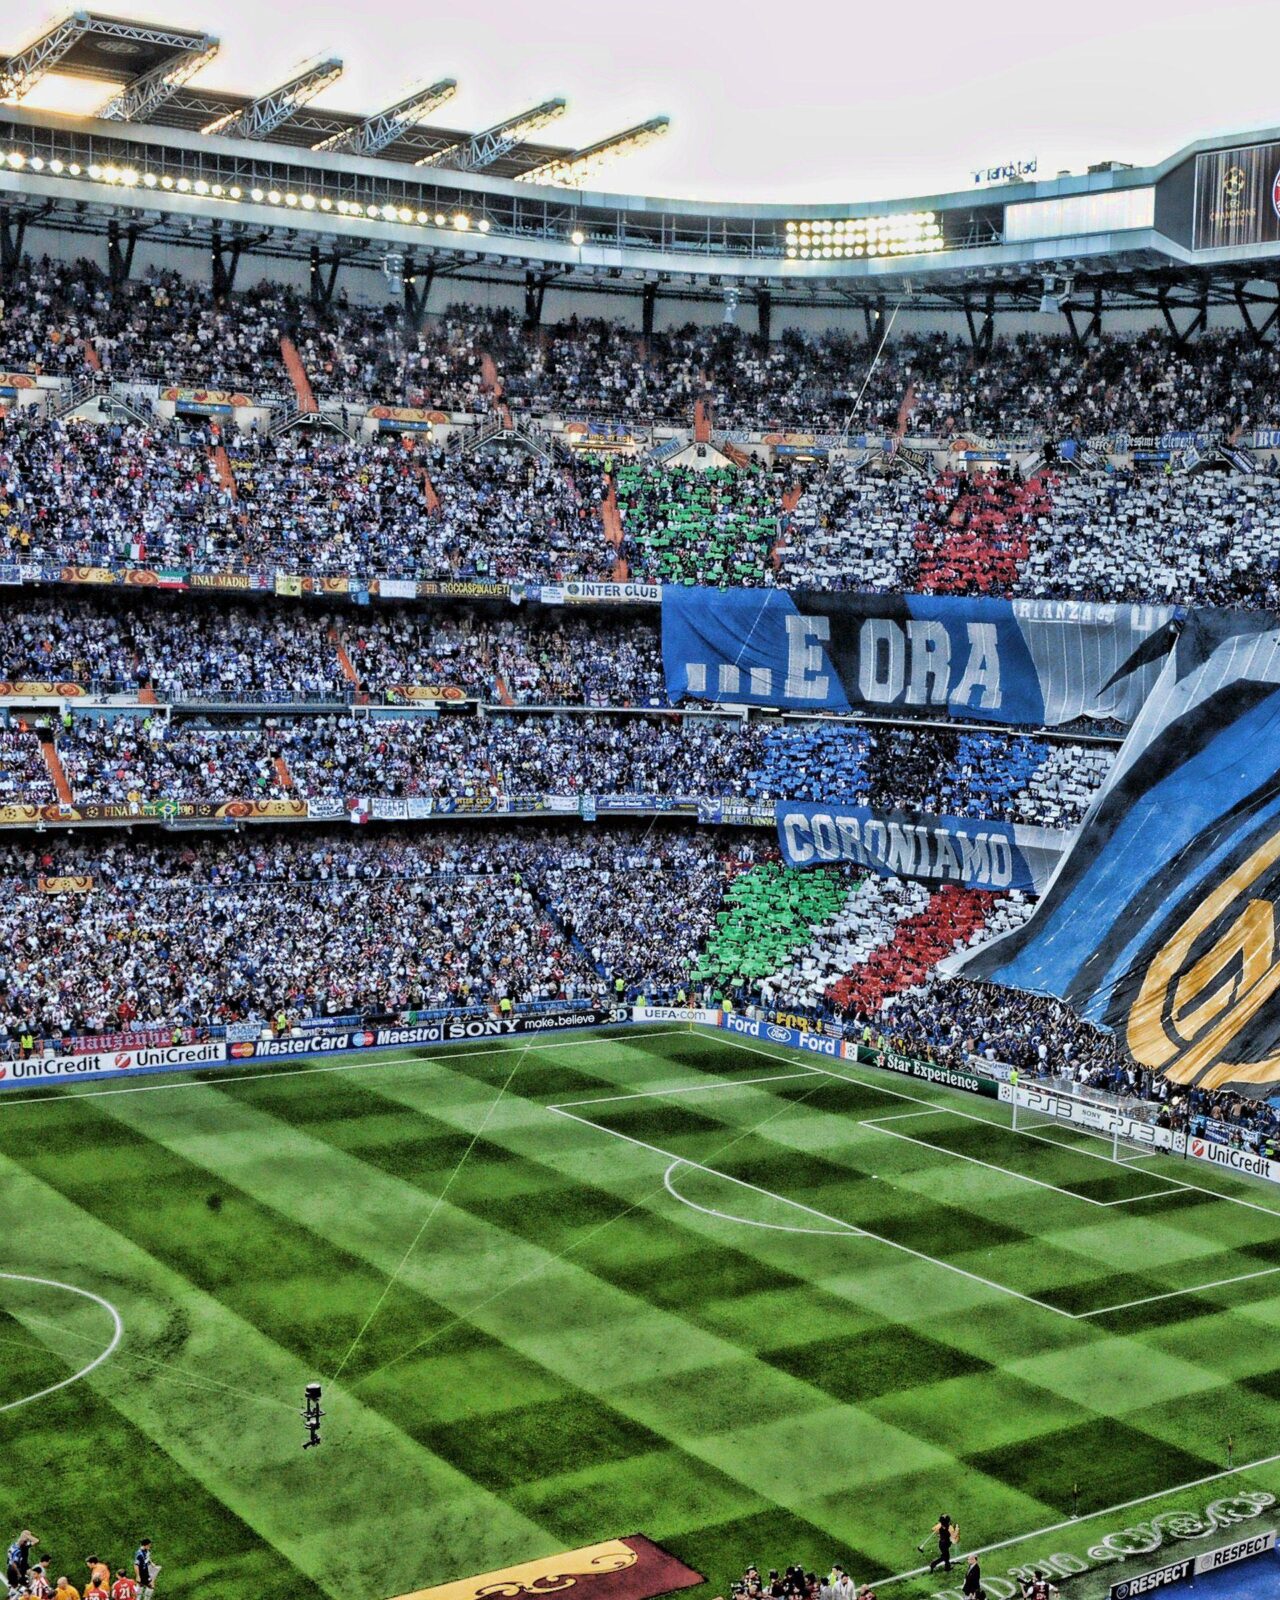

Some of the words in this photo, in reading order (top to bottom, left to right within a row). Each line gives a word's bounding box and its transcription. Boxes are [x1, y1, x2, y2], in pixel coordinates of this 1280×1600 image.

[582, 584, 620, 597] INTER
[624, 585, 658, 599] CLUB
[859, 618, 1002, 708] ORA
[783, 812, 1013, 887] CORONIAMO
[376, 1027, 440, 1046] Maestro
[449, 1019, 521, 1039] SONY
[525, 1014, 596, 1030] make.believe
[727, 1013, 760, 1036] Ford
[256, 1033, 349, 1057] MasterCard
[799, 1032, 836, 1055] Ford
[13, 1056, 101, 1079] UniCredit
[136, 1044, 220, 1069] UniCredit
[887, 1054, 911, 1074] Star
[914, 1058, 979, 1092] Experience
[1027, 1092, 1073, 1119] PS3
[1082, 1108, 1102, 1120] SONY
[1108, 1114, 1156, 1144] PS3
[1207, 1145, 1270, 1178] UniCredit
[1212, 1534, 1272, 1567] RESPECT
[1128, 1560, 1190, 1597] RESPECT
[119, 1587, 131, 1600] 21
